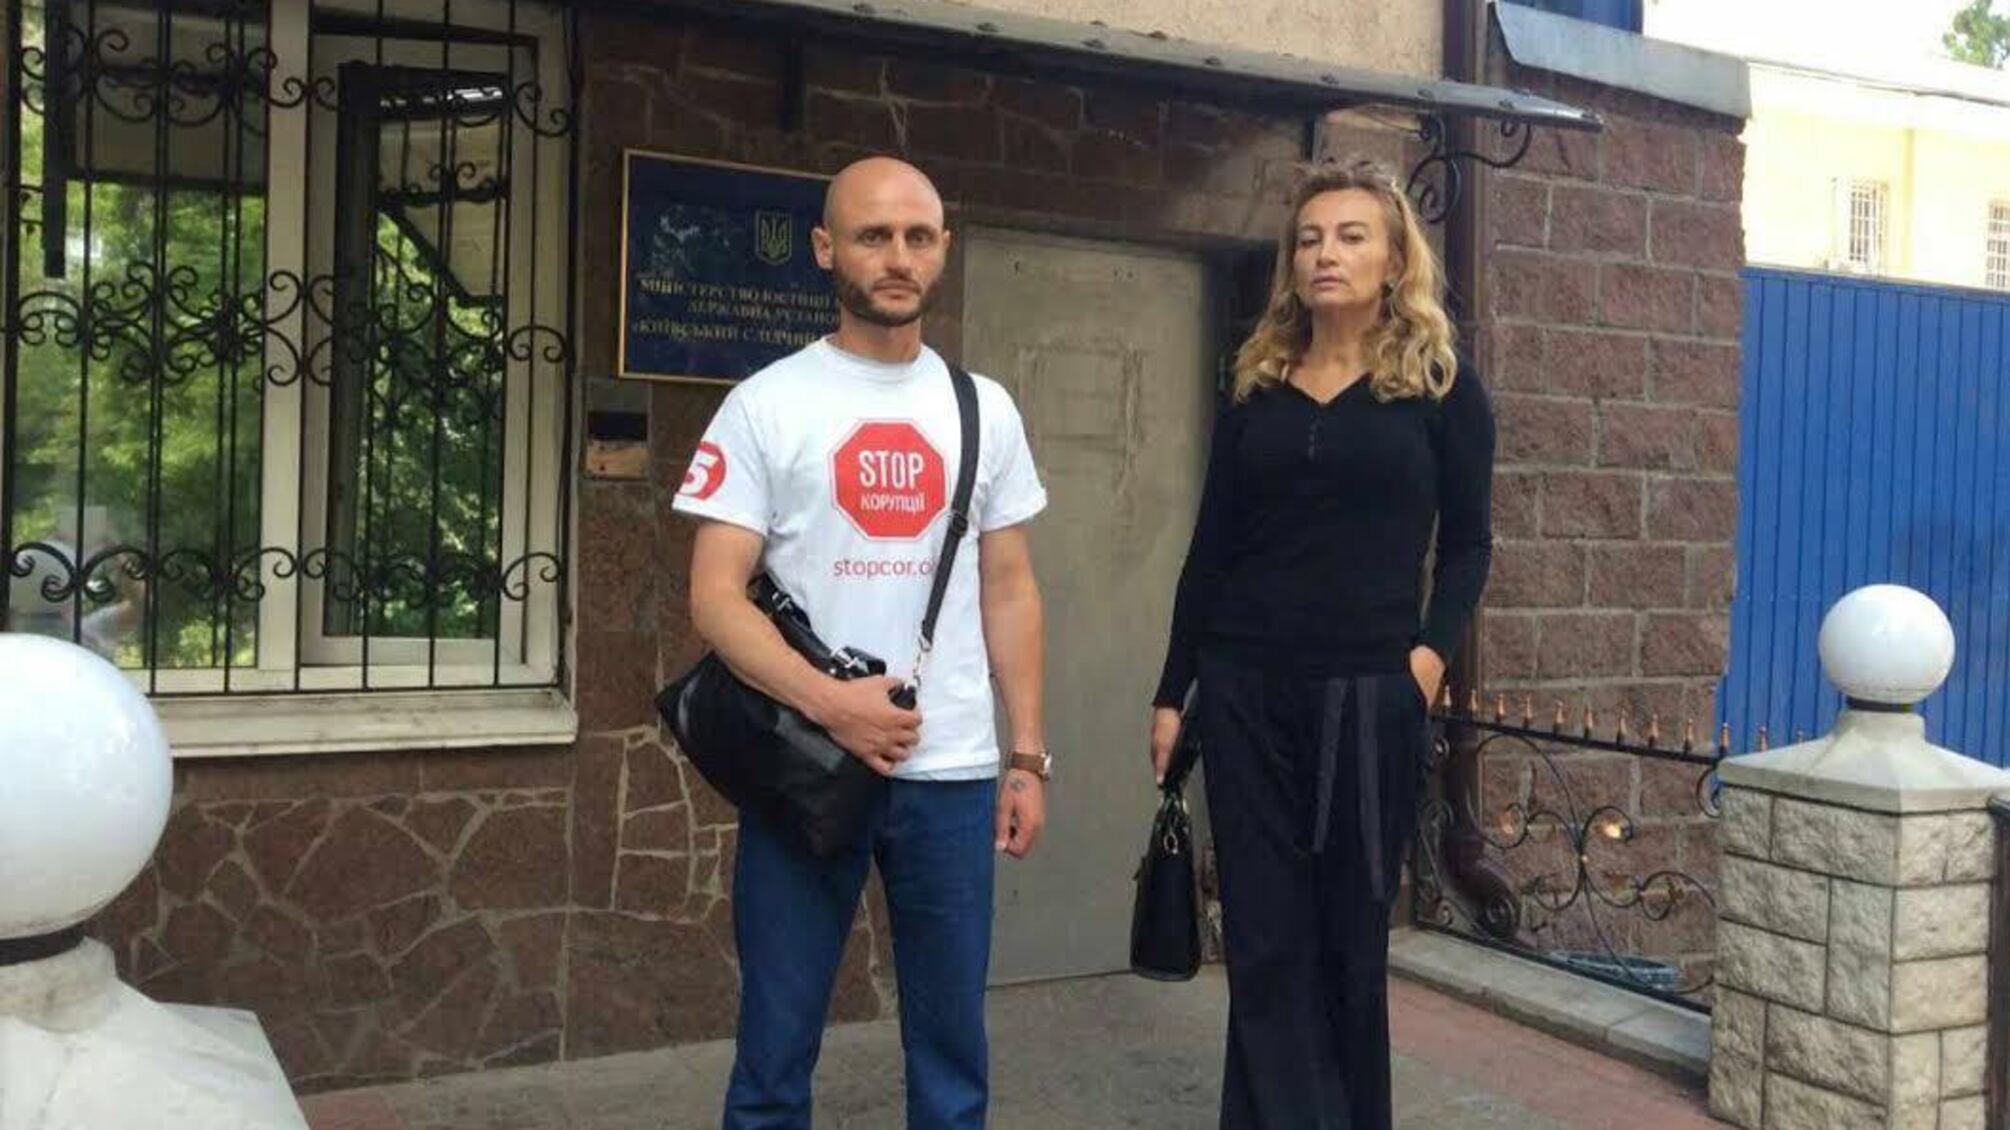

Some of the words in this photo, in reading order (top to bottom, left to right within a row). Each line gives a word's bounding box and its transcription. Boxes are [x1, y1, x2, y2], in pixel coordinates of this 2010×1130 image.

[680, 449, 719, 494] 5
[859, 450, 924, 489] STOP
[861, 492, 925, 515] КОРУПЦІЇ
